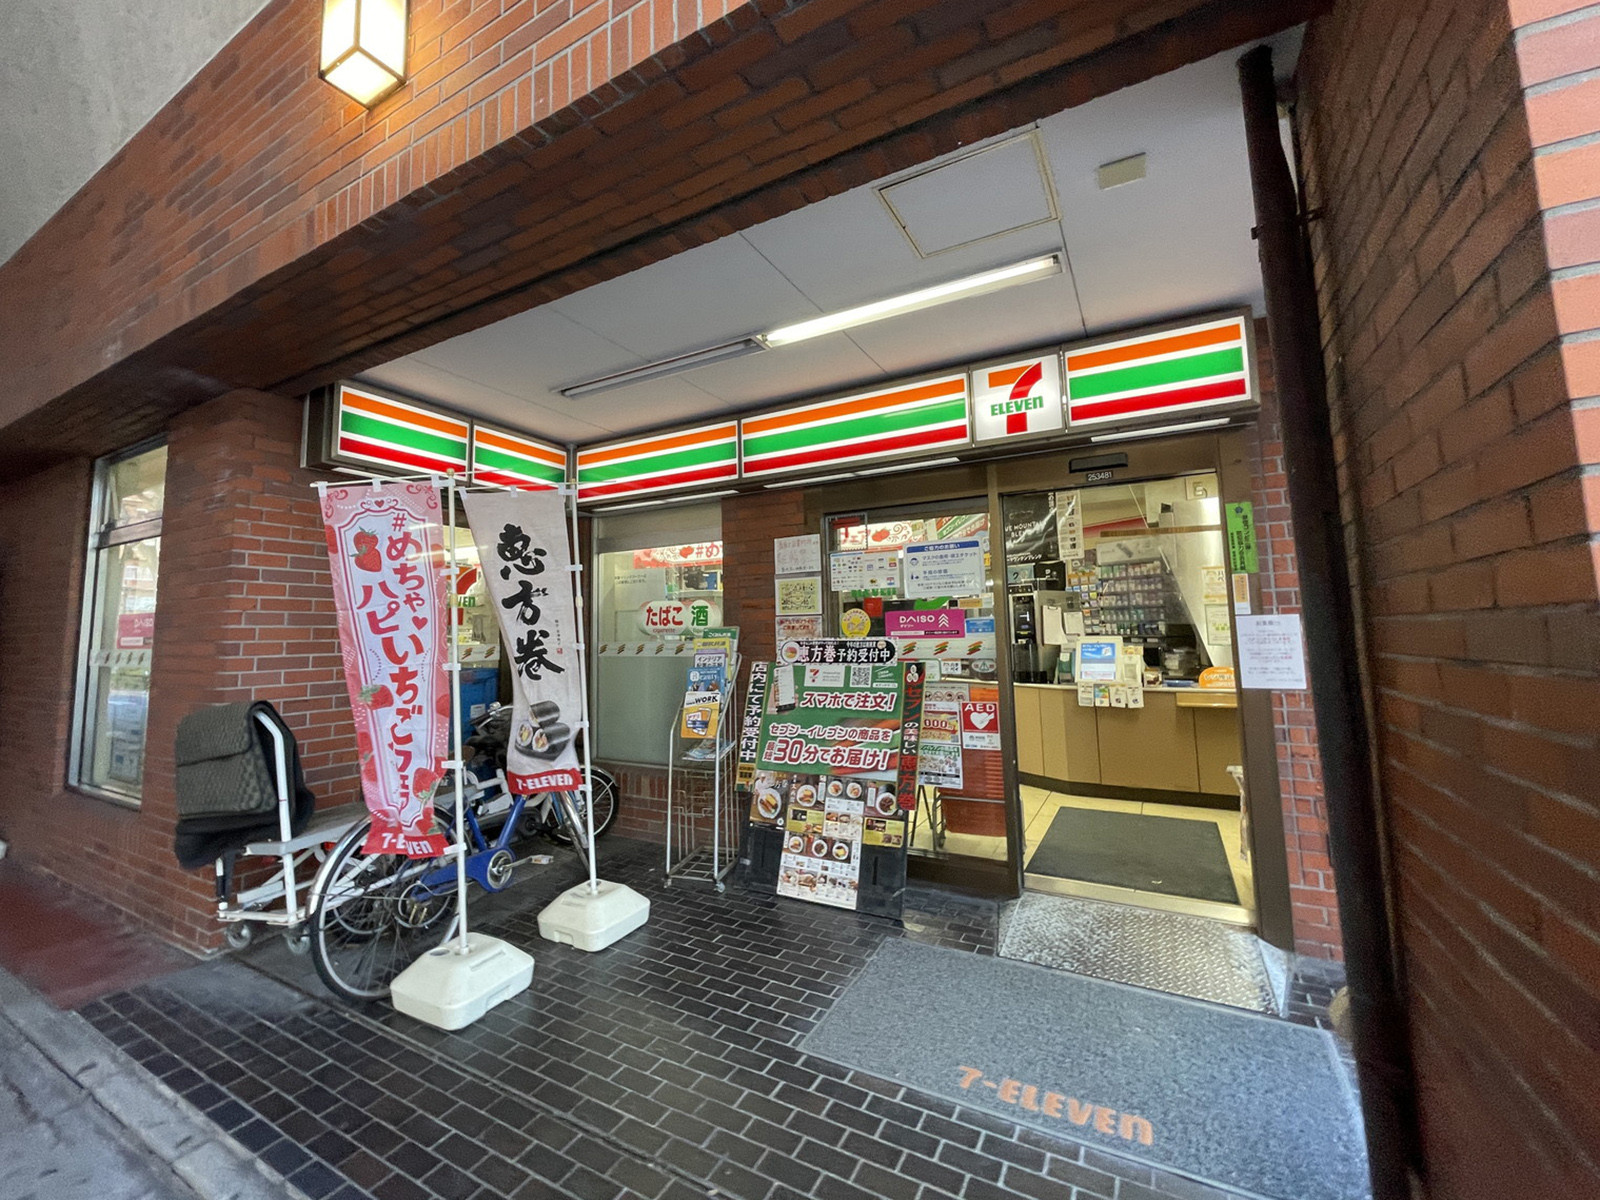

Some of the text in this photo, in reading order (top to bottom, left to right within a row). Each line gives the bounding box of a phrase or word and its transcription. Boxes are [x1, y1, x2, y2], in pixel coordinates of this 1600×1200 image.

[988, 361, 1042, 434] 7
[1087, 472, 1112, 481] 253481
[646, 606, 683, 626] たばこ
[691, 605, 708, 626] 酒
[899, 614, 935, 624] DAISO
[798, 645, 890, 663] 恵方巻予約受付中
[695, 695, 718, 704] WORK
[964, 703, 995, 711] AED
